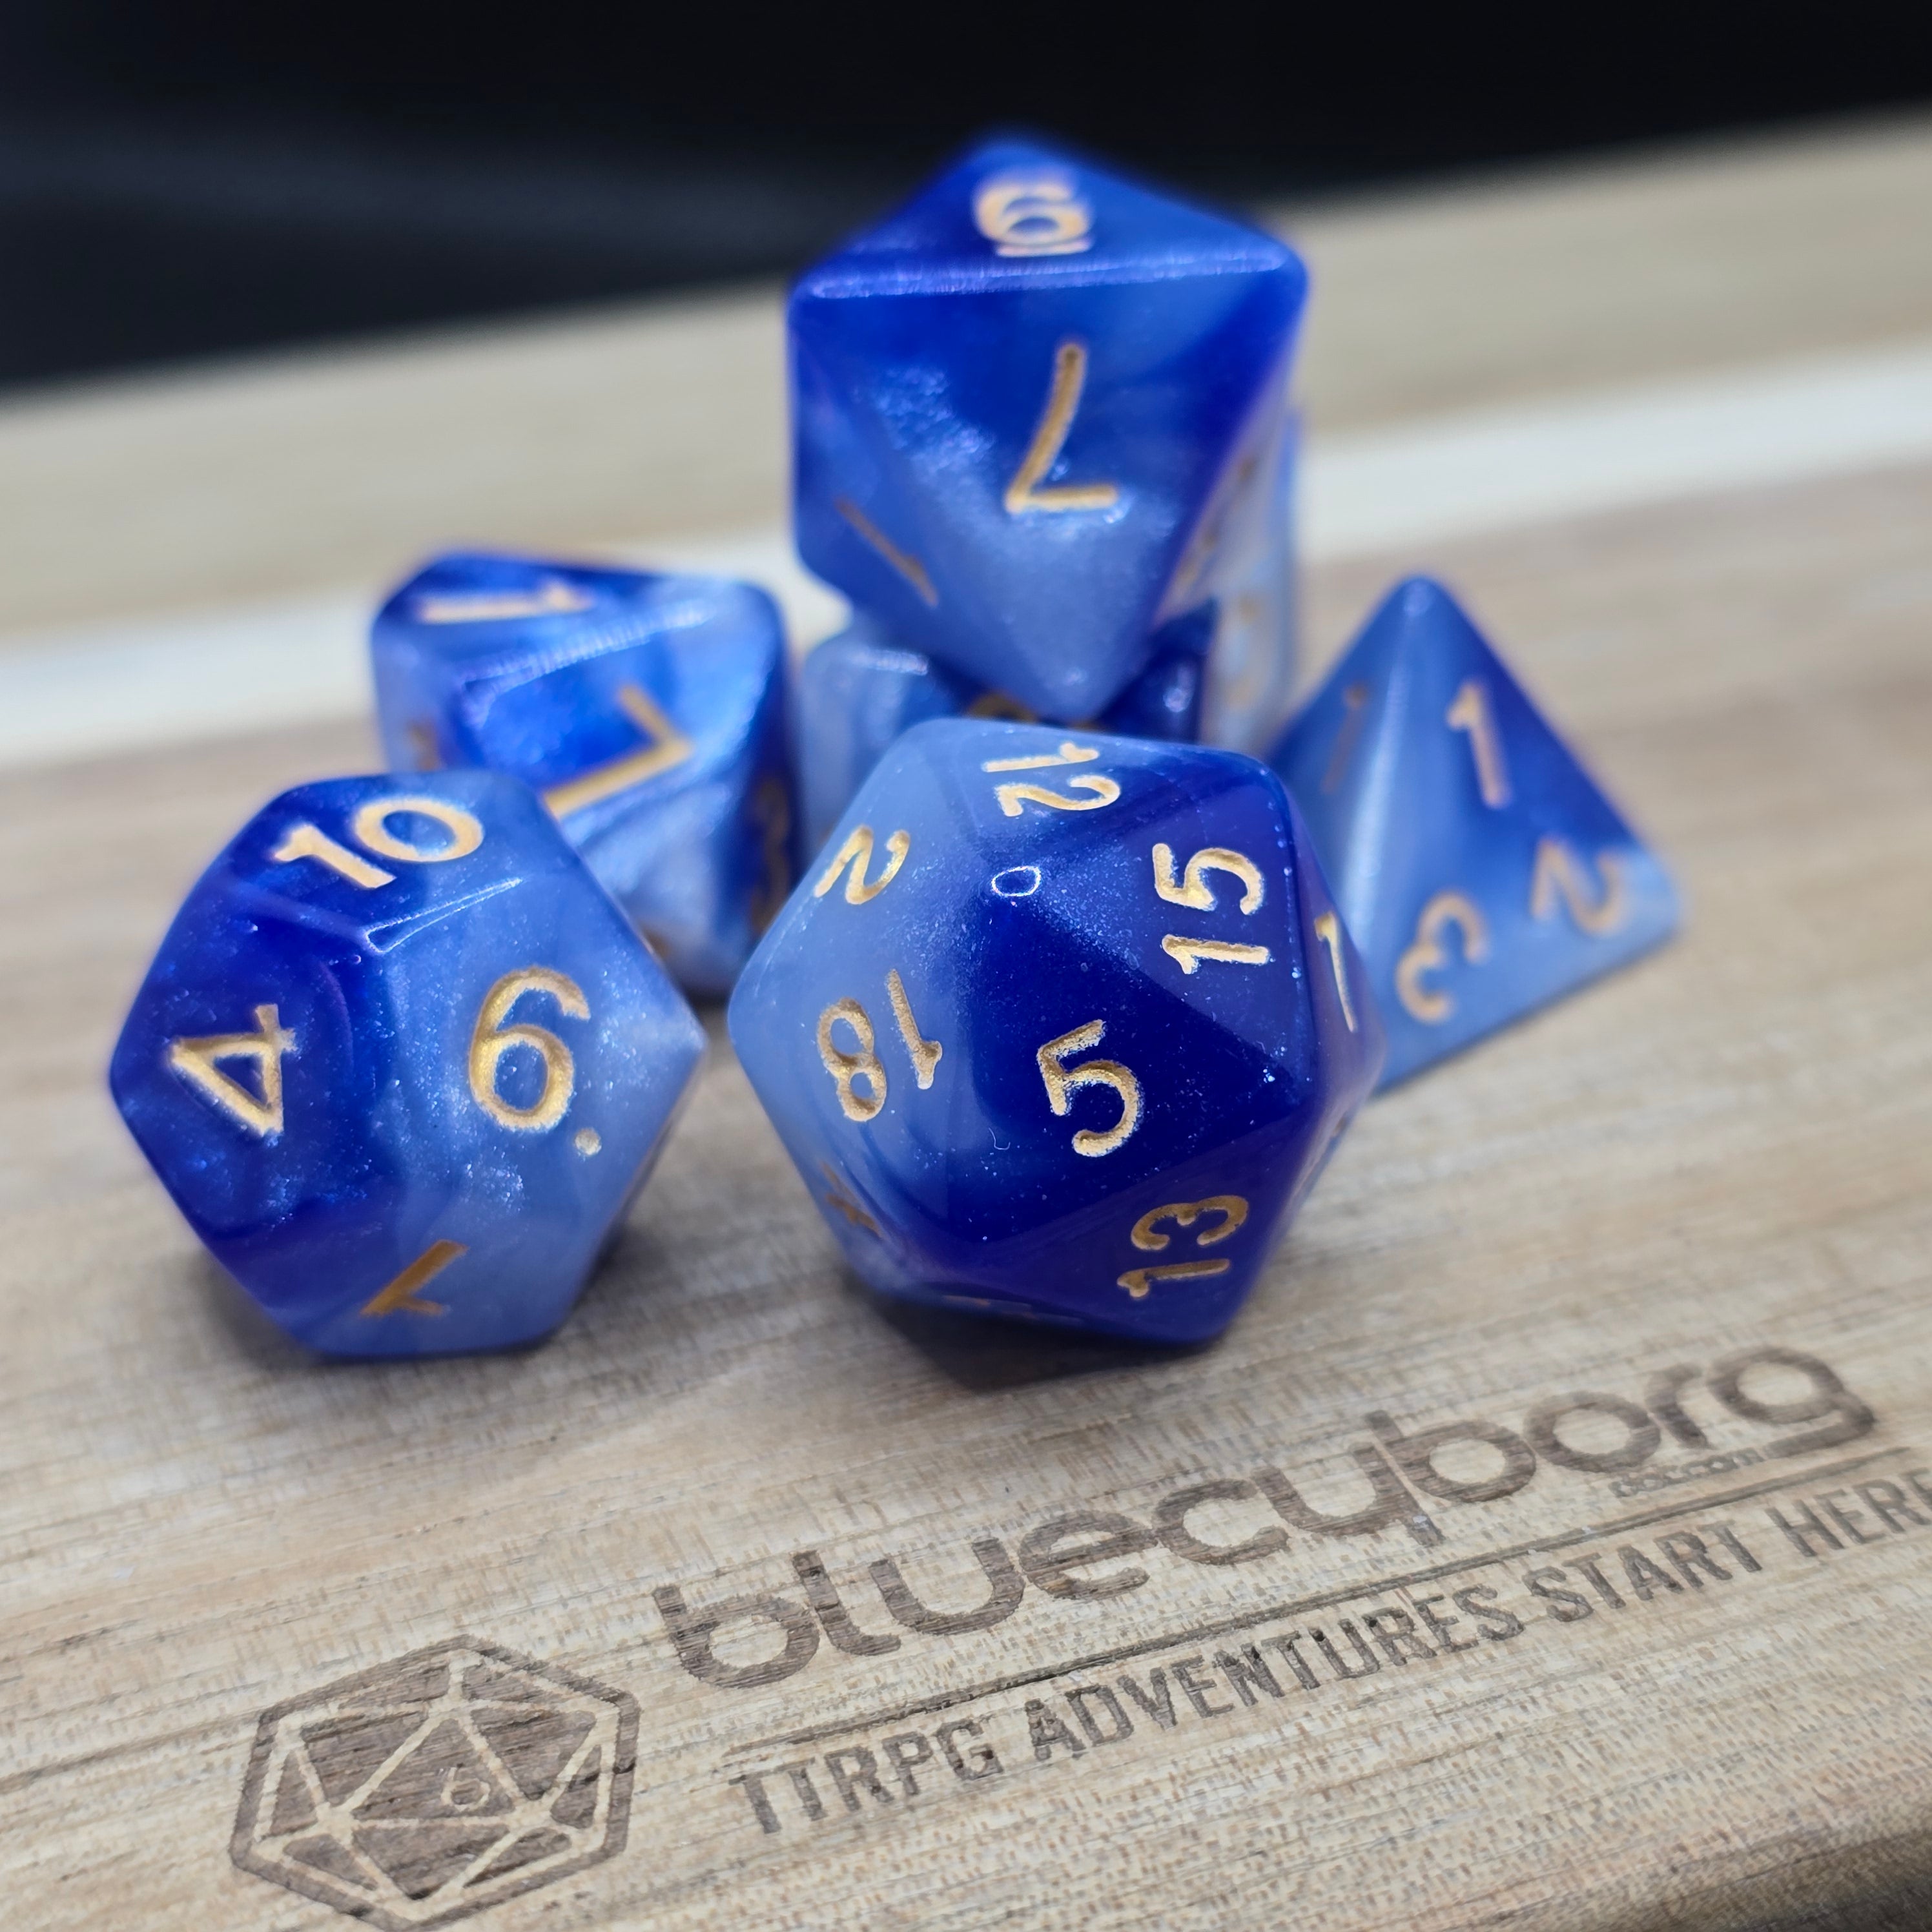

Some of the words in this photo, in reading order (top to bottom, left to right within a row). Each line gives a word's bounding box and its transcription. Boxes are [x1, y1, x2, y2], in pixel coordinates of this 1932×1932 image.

[1005, 341, 1118, 515] 7
[983, 741, 1121, 817] 12
[1443, 677, 1512, 812] 1
[271, 796, 486, 890] 10
[814, 825, 912, 905] 2
[1152, 842, 1272, 975] 15
[1529, 836, 1635, 938] 2
[1395, 888, 1490, 1023] 3
[165, 1003, 298, 1143] 4
[815, 967, 944, 1124] 18
[1036, 1018, 1143, 1158] 5
[1116, 1194, 1250, 1299] 13
[652, 1346, 1876, 1690] bluecyborg
[728, 1716, 1005, 1835] TTRPG
[1024, 1582, 1525, 1763] ADVENTURES
[1523, 1517, 1764, 1623] START
